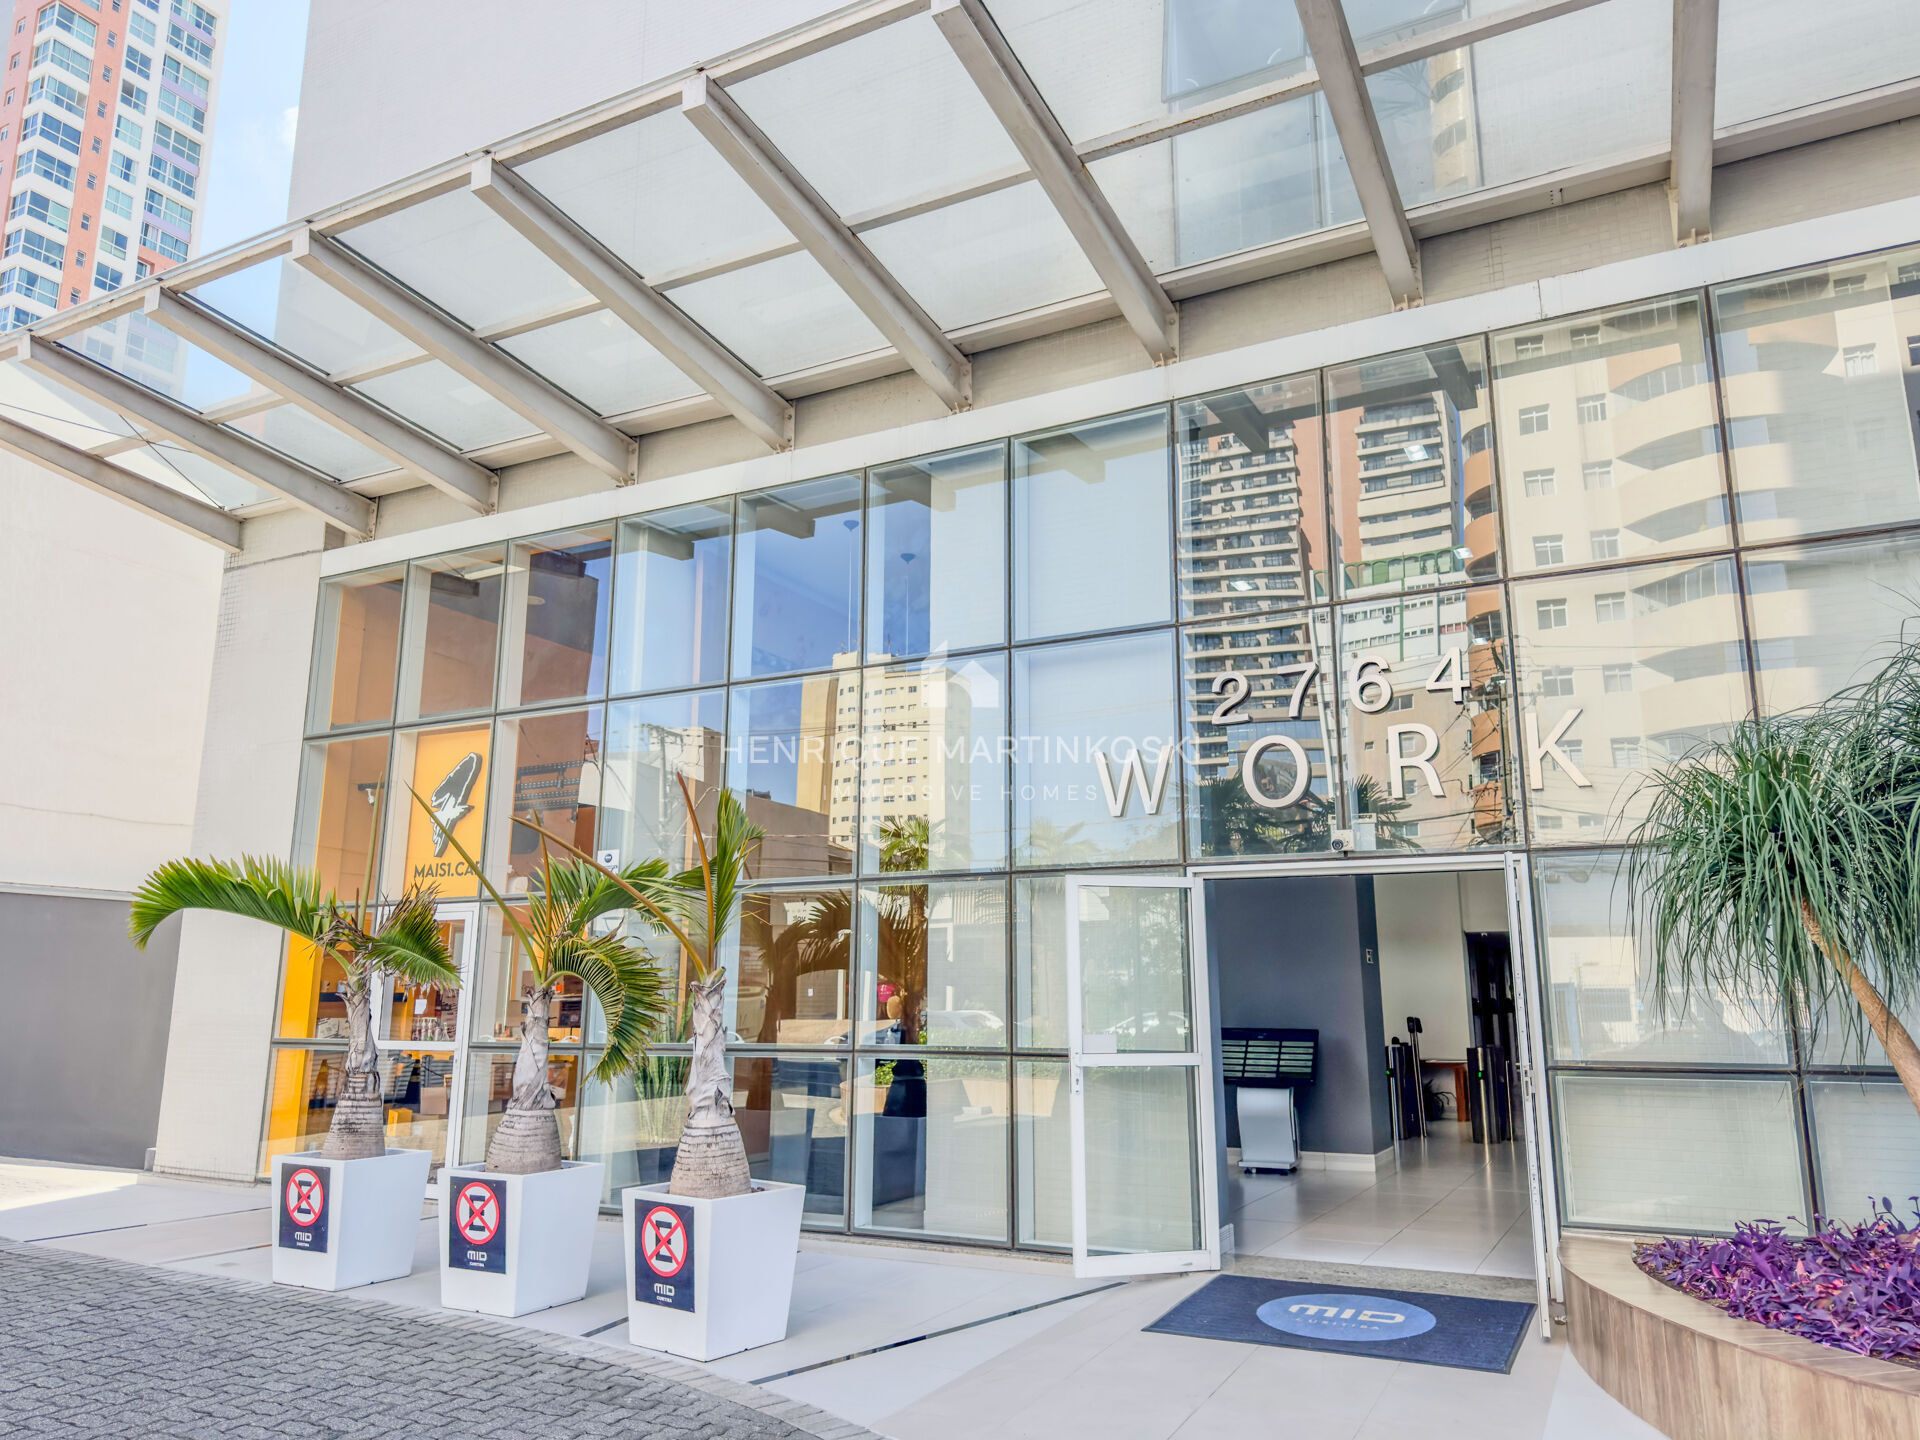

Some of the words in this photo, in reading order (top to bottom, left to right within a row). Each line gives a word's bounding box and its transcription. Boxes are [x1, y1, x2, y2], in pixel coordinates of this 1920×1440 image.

[1211, 647, 1472, 725] 2764
[1095, 708, 1592, 818] WORK
[294, 1231, 312, 1242] MID
[467, 1250, 487, 1262] MID
[653, 1282, 675, 1297] MID
[1288, 1304, 1406, 1324] MID
